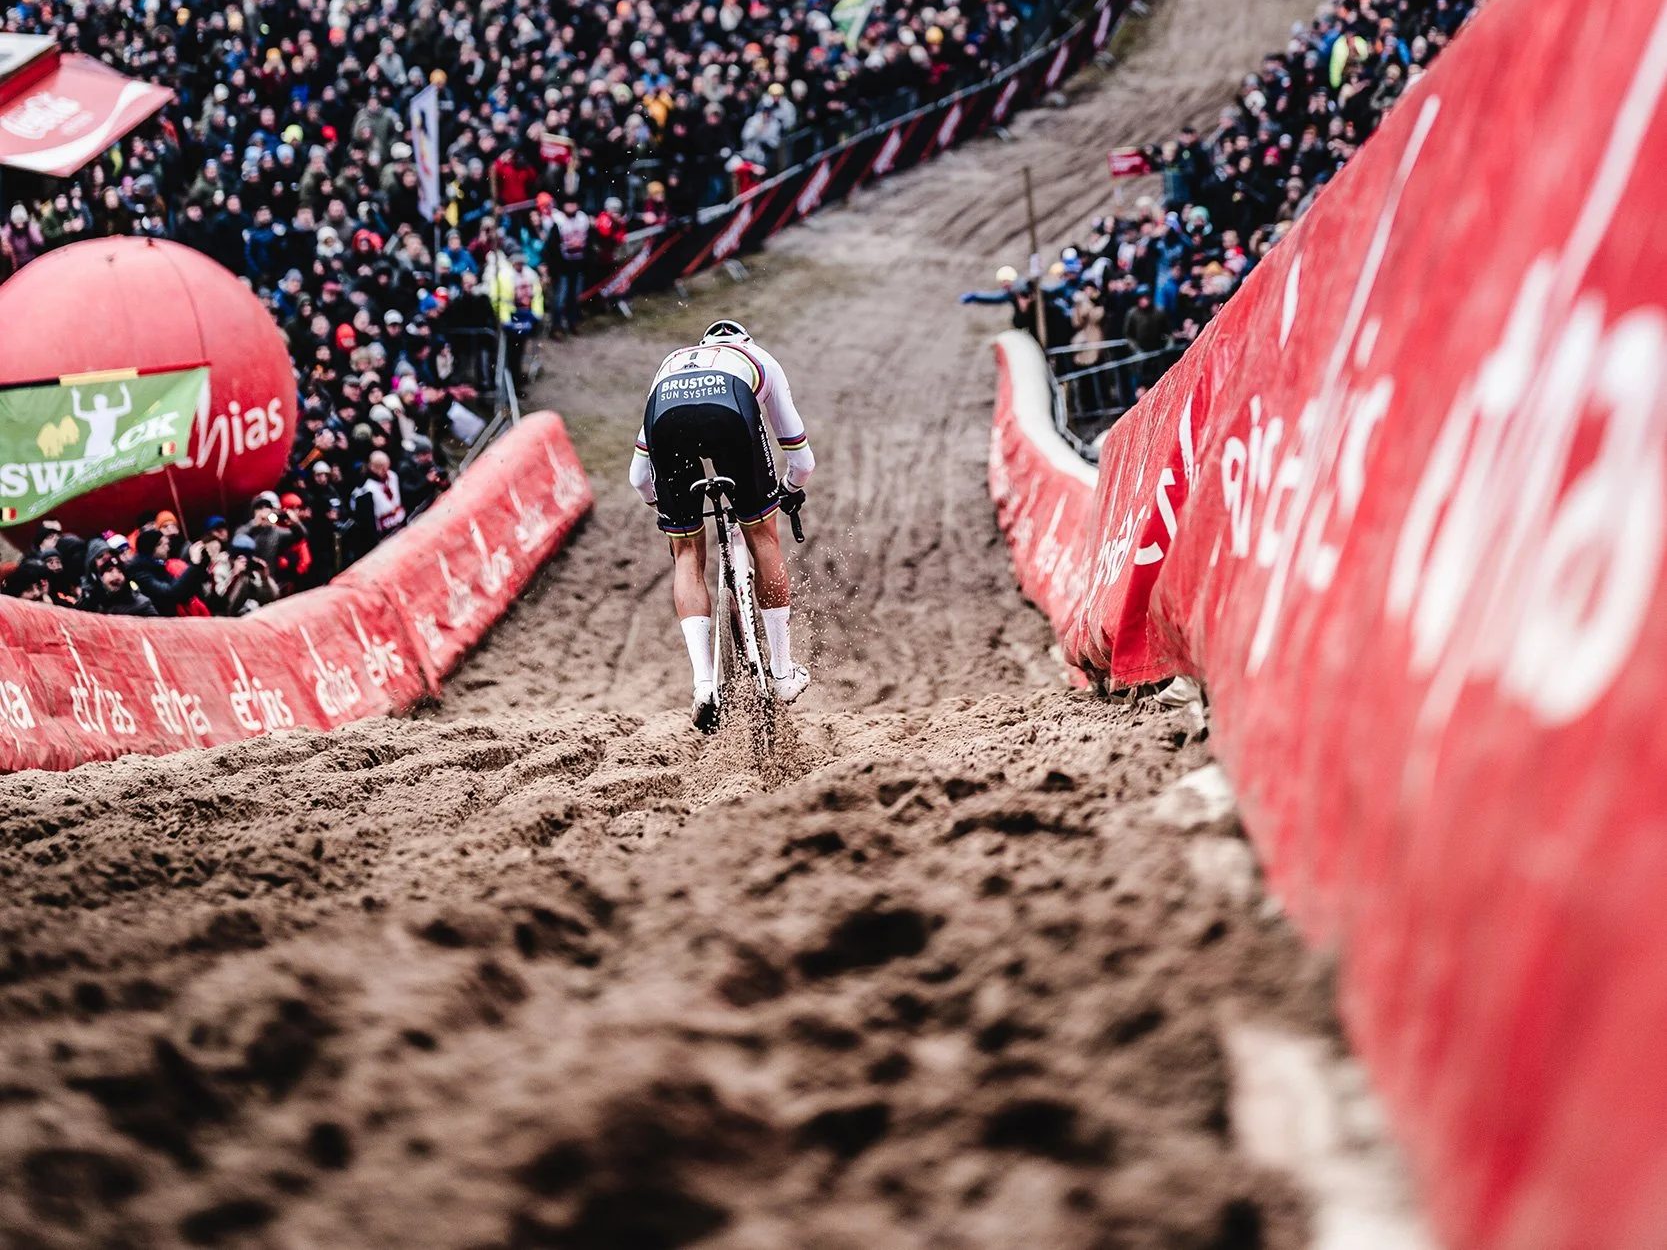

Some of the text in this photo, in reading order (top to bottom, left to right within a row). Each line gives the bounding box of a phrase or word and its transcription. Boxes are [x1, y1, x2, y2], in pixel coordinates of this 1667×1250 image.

[661, 375, 726, 392] BRUSTOR
[661, 386, 727, 401] SUN SYSTEMS
